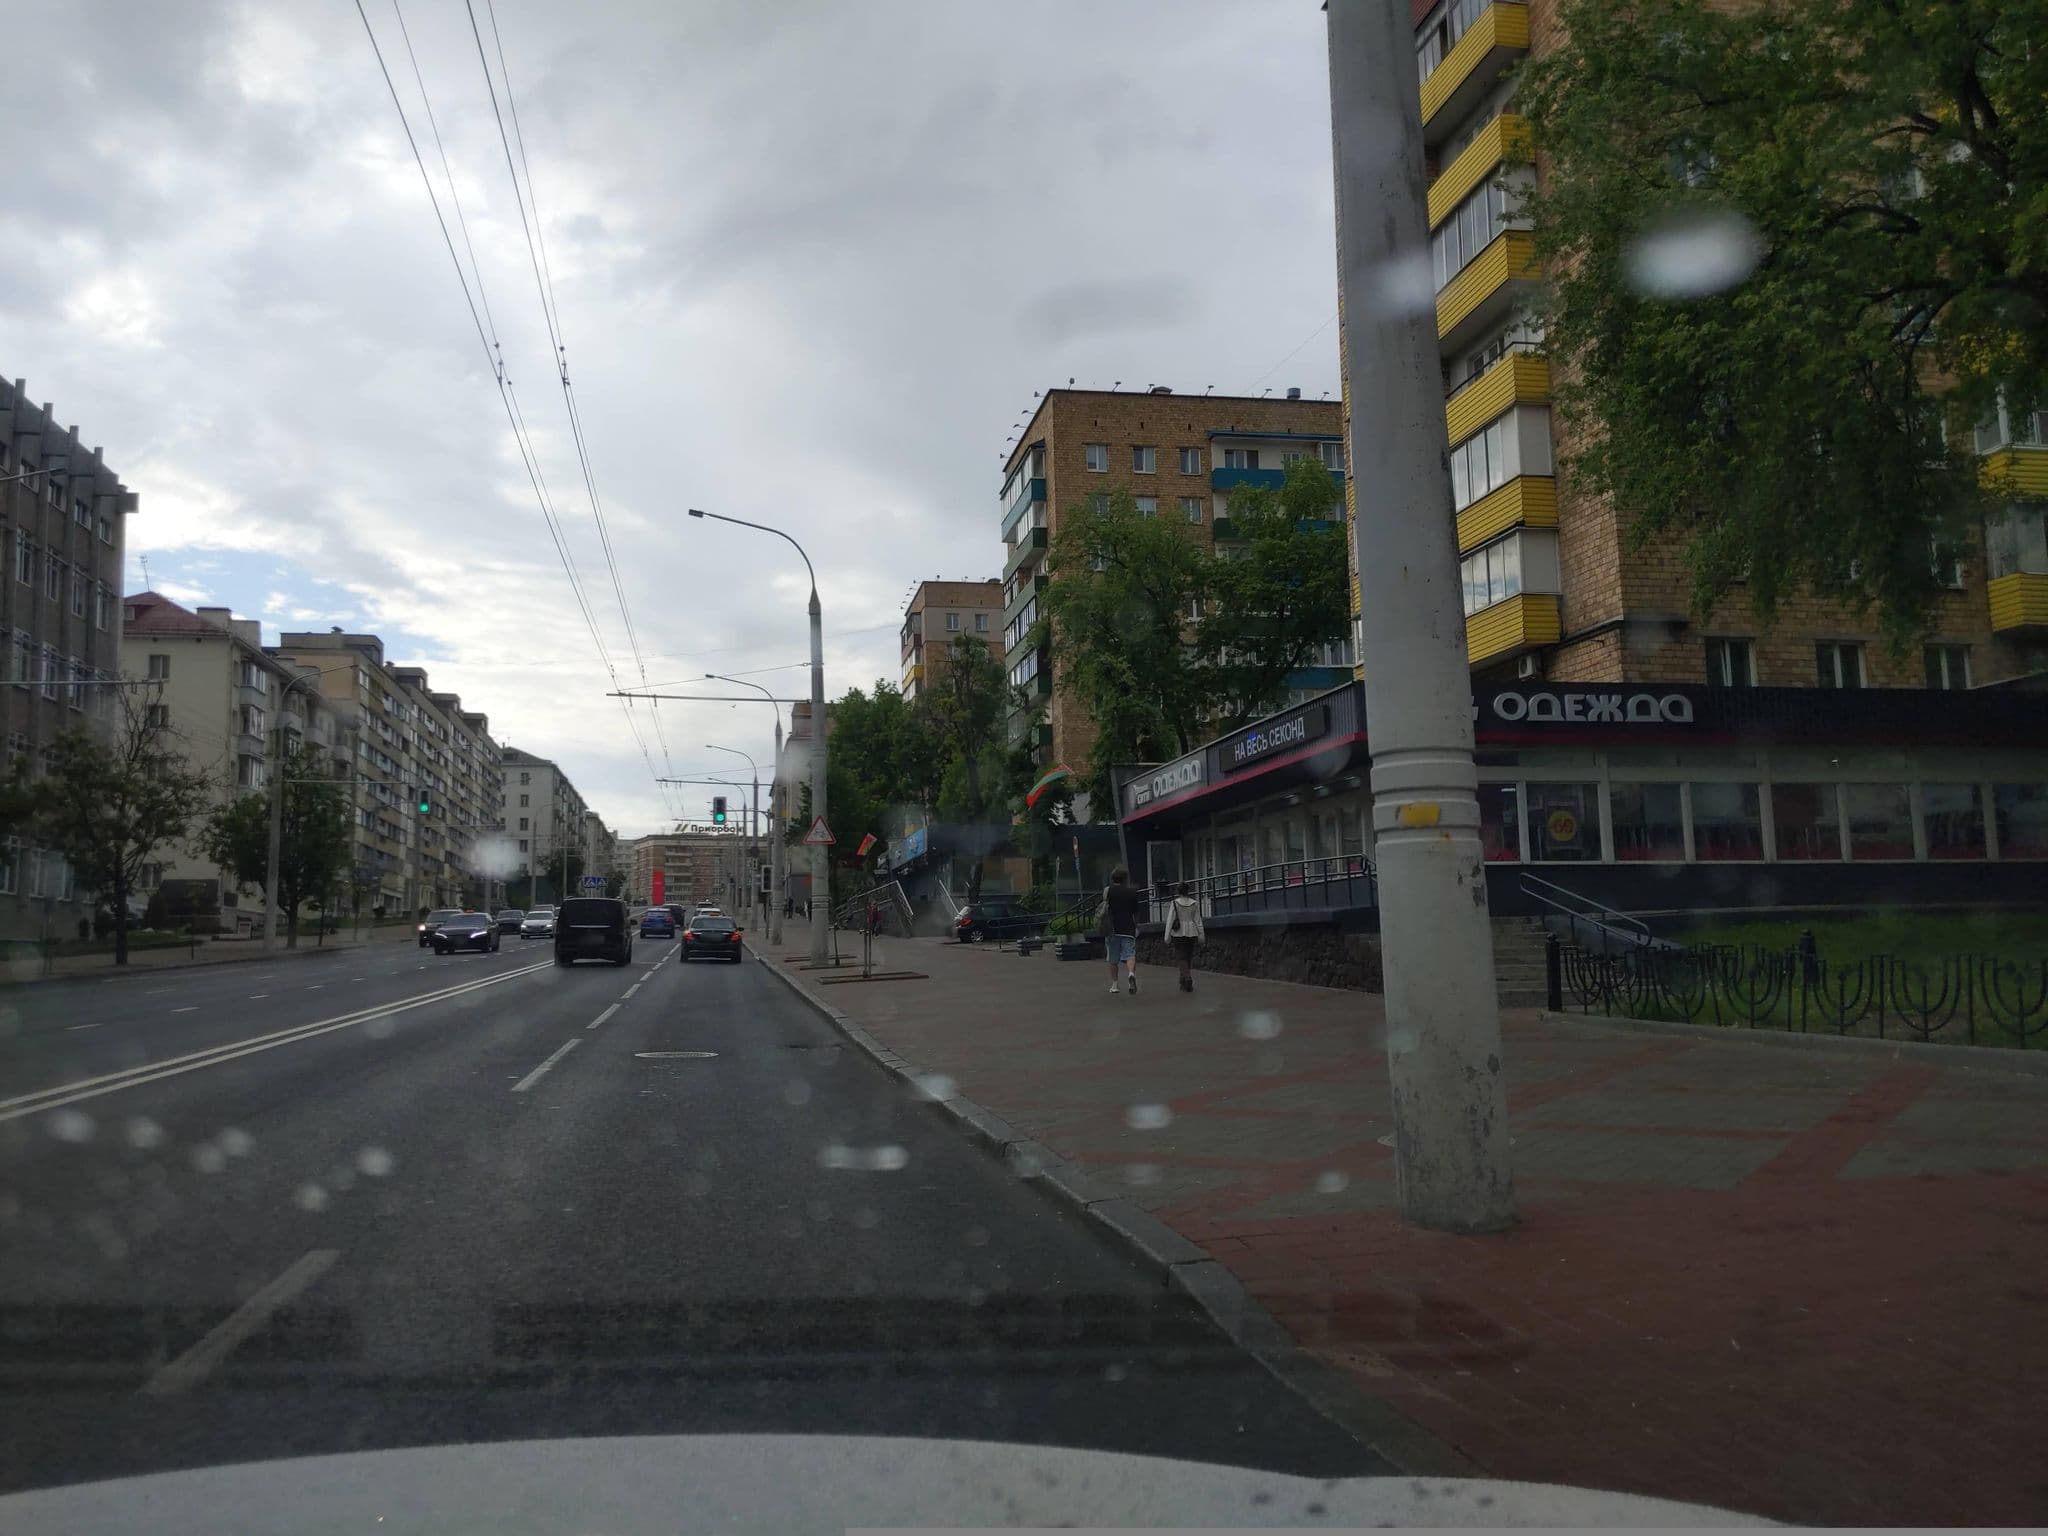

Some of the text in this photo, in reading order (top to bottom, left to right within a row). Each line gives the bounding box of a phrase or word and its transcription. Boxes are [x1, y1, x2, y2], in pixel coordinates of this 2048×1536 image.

[1493, 691, 1694, 722] ОДЕЖДА
[1234, 717, 1305, 761] НА ВЕСЬ СЕКОНД
[1153, 760, 1200, 797] ОДЕЖДА
